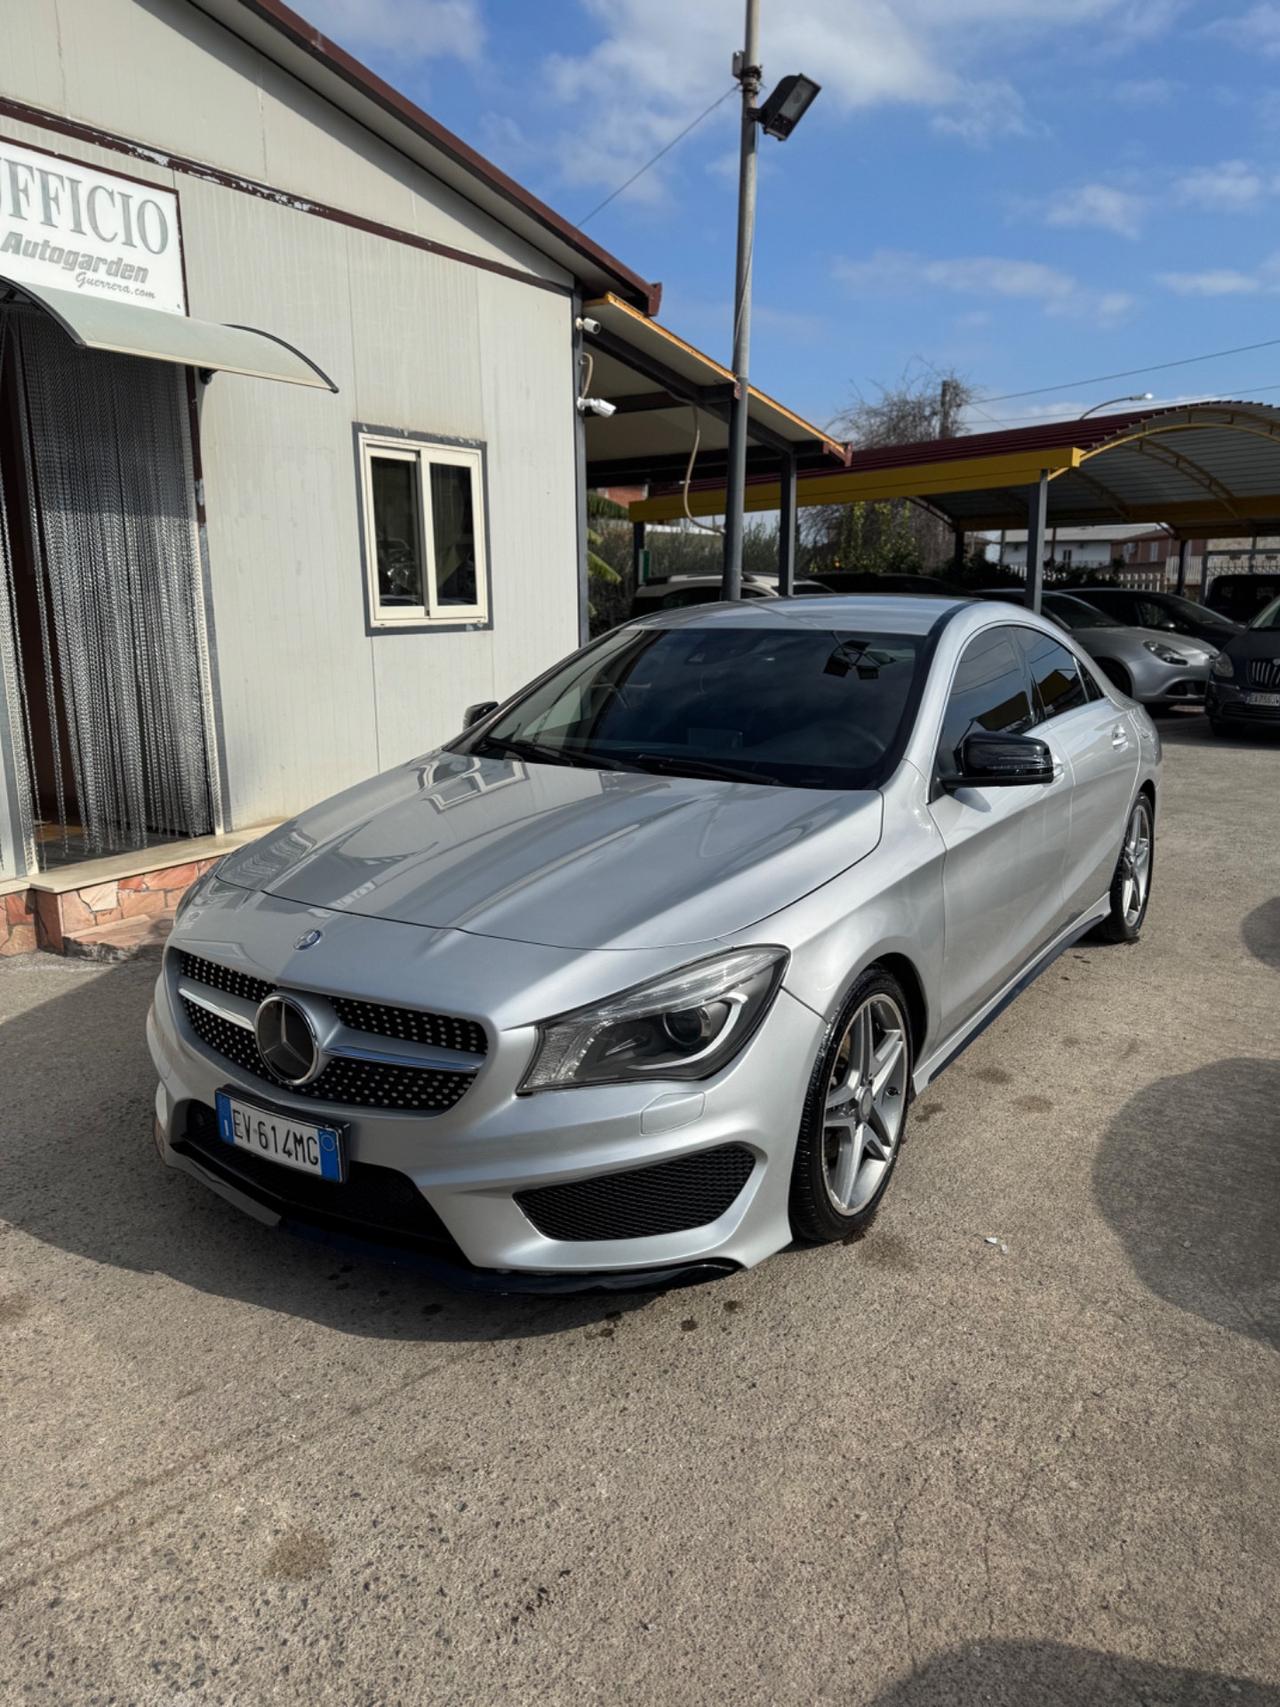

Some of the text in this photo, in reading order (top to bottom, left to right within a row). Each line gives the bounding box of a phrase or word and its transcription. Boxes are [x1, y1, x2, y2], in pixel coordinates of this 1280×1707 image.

[0, 157, 169, 255] FFICIO
[0, 231, 149, 283] Autogarden
[75, 271, 156, 300] Guerrera.com
